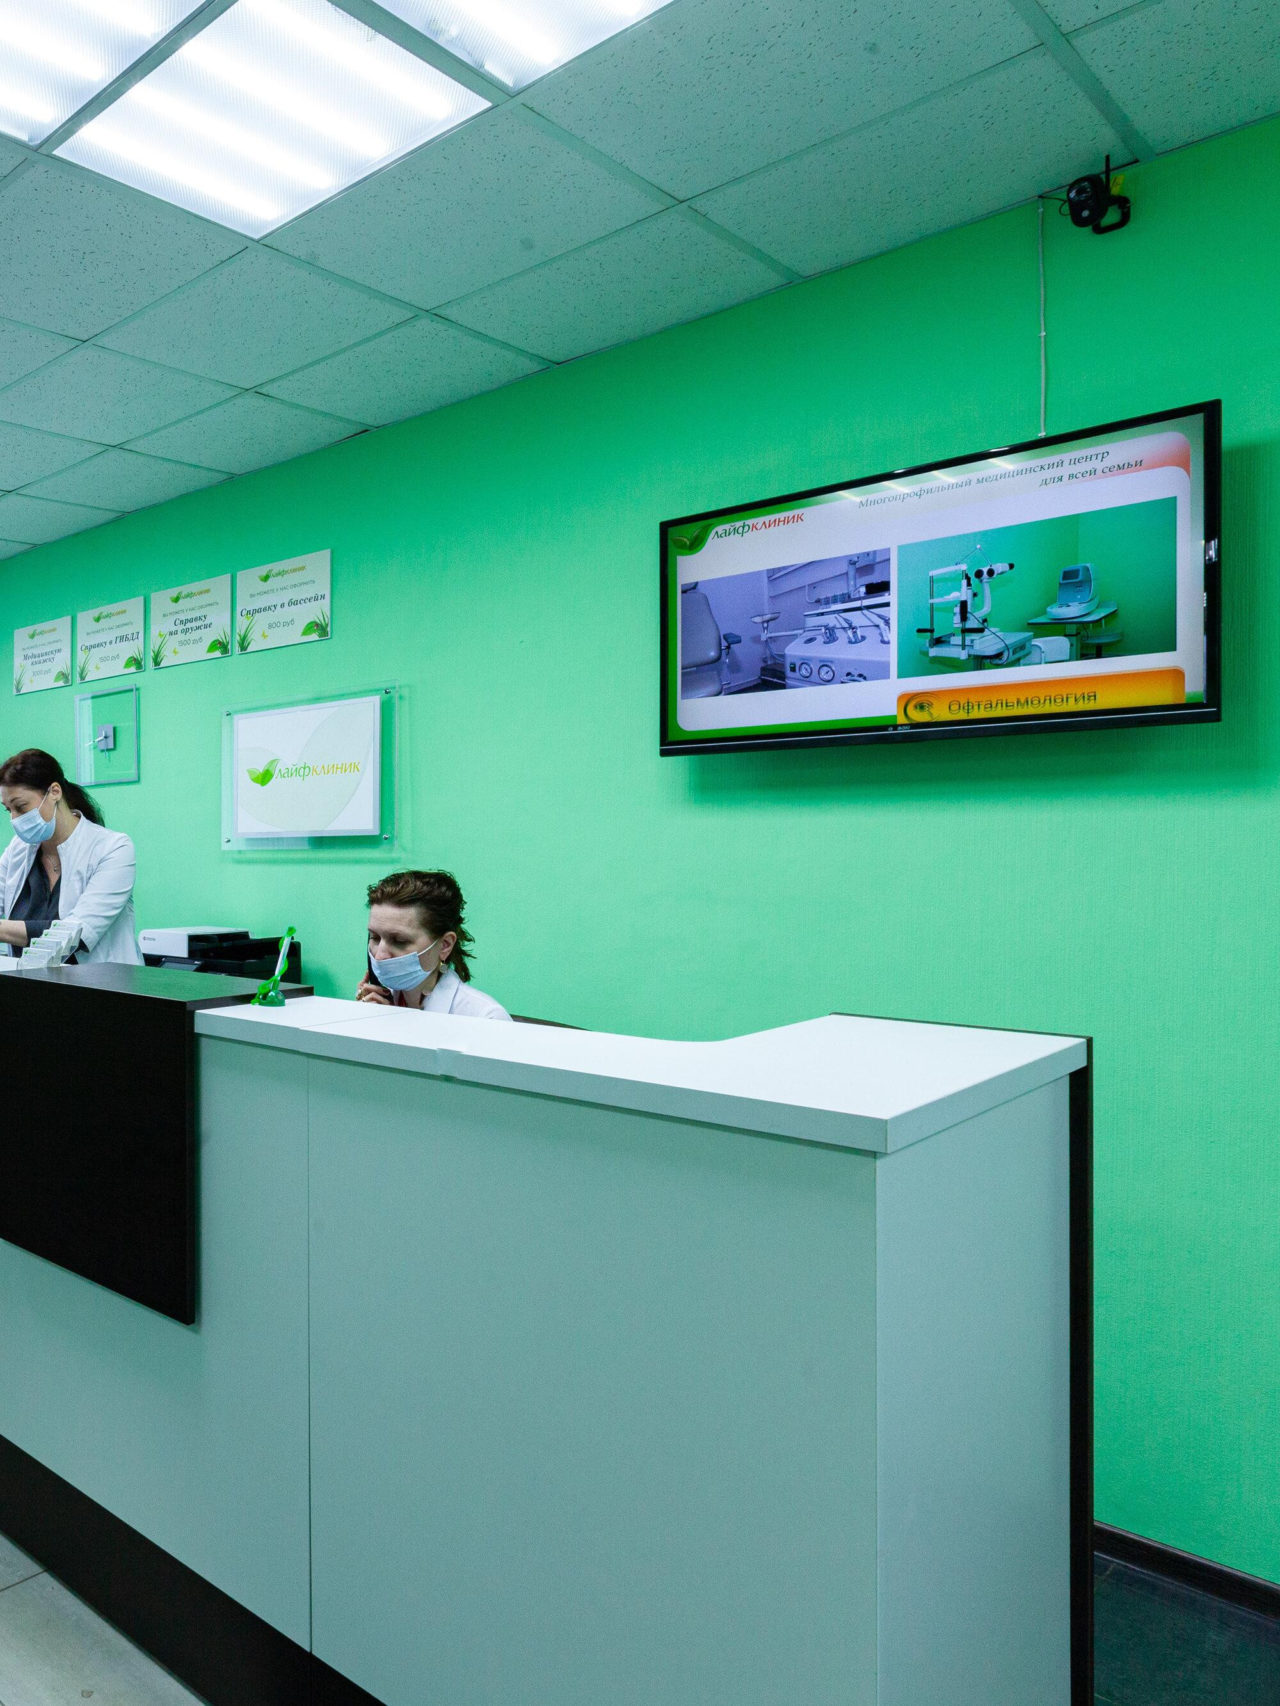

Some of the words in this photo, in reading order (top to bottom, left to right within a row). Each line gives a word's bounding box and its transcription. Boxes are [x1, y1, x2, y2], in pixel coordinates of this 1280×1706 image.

[858, 478, 972, 509] Многопрофильный
[975, 459, 1064, 485] медицинский
[1068, 450, 1110, 467] центр
[1039, 474, 1063, 488] для
[1067, 467, 1098, 481] всей
[1101, 458, 1144, 473] семьи
[711, 512, 805, 540] лайфклиник
[240, 603, 278, 617] Справку
[287, 592, 326, 607] бассейн
[168, 629, 179, 637] на
[180, 622, 213, 636] оружие
[174, 614, 208, 627] Справку
[267, 620, 280, 630] 800
[282, 618, 295, 629] руб
[80, 641, 107, 652] Справку
[114, 631, 140, 645] ГИБДД
[948, 690, 1097, 717] Офтальмология
